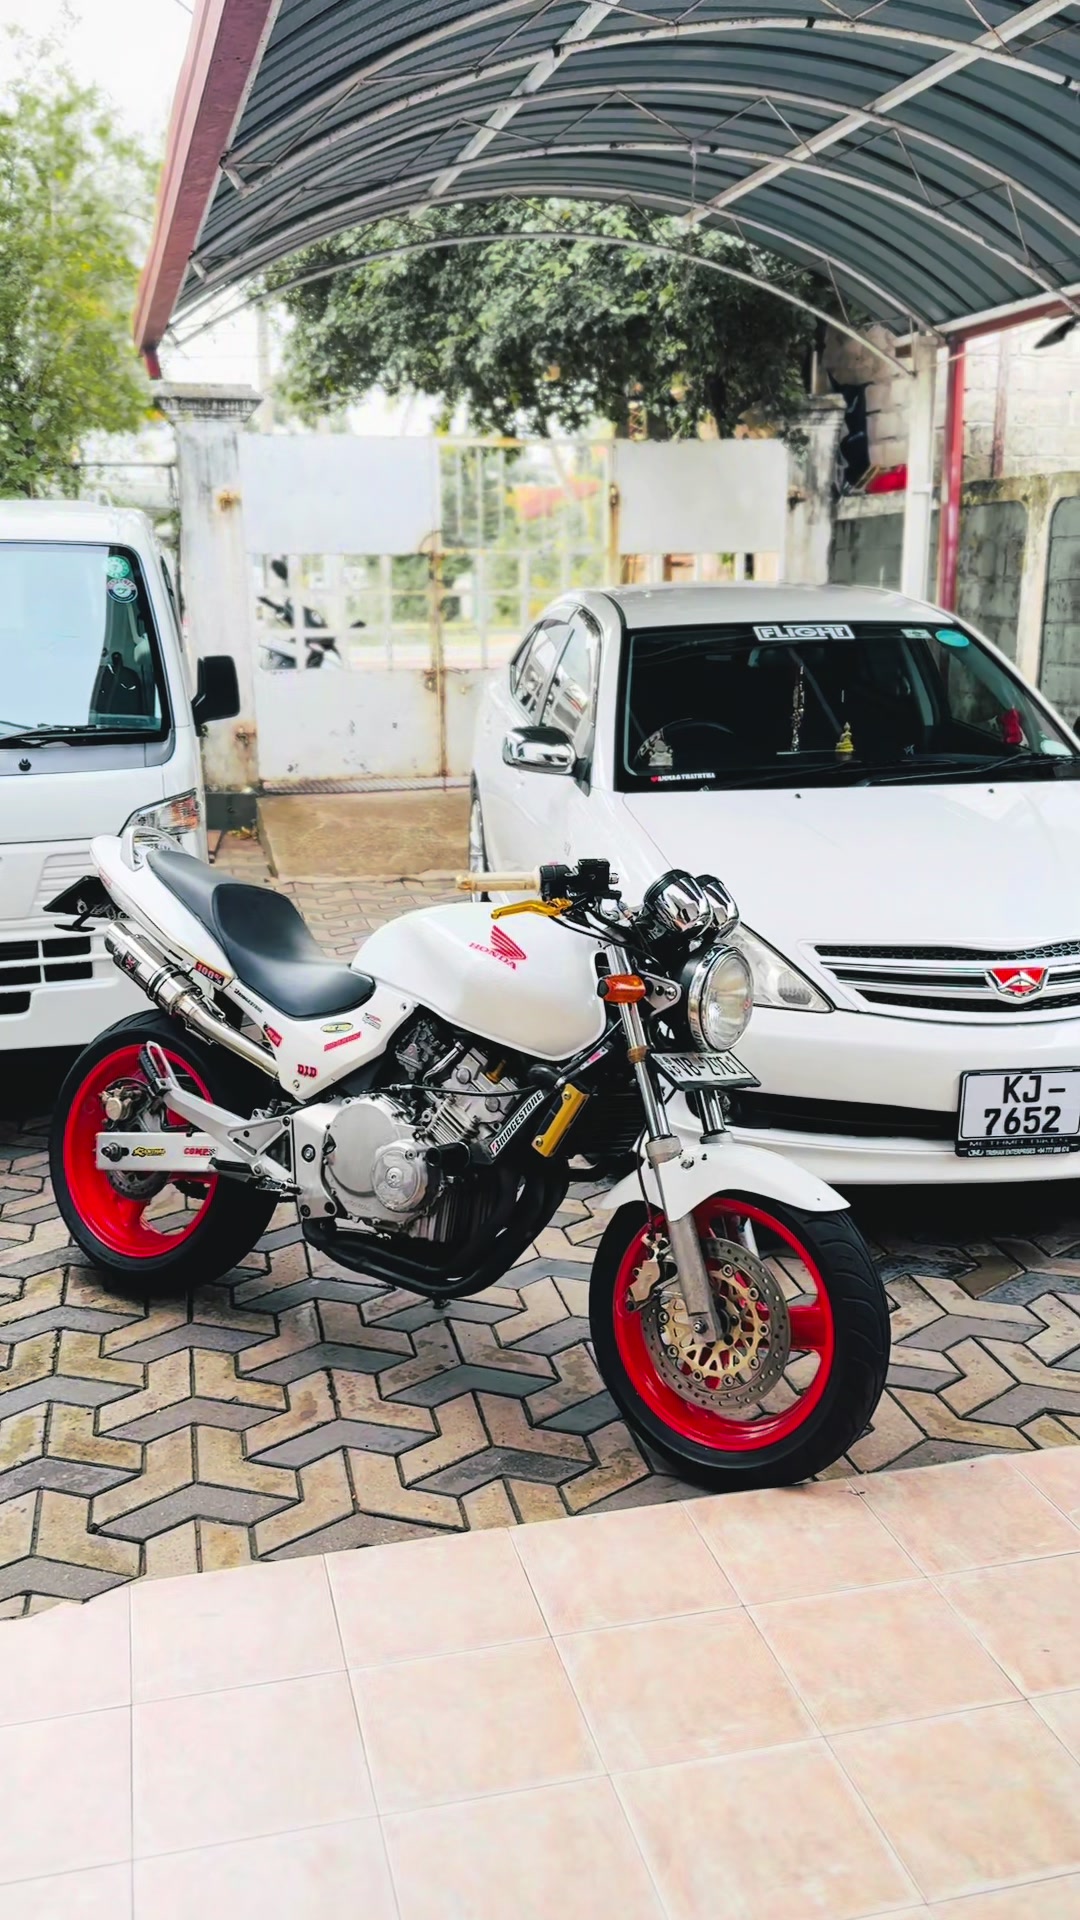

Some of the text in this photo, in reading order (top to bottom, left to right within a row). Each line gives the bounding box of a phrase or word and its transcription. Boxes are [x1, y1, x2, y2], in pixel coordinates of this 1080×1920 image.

[757, 625, 852, 640] FLIGHT
[468, 942, 516, 970] HONDA
[196, 962, 224, 985] 100%
[491, 1091, 544, 1154] BRIDGESTONE
[984, 1106, 1061, 1136] 7652
